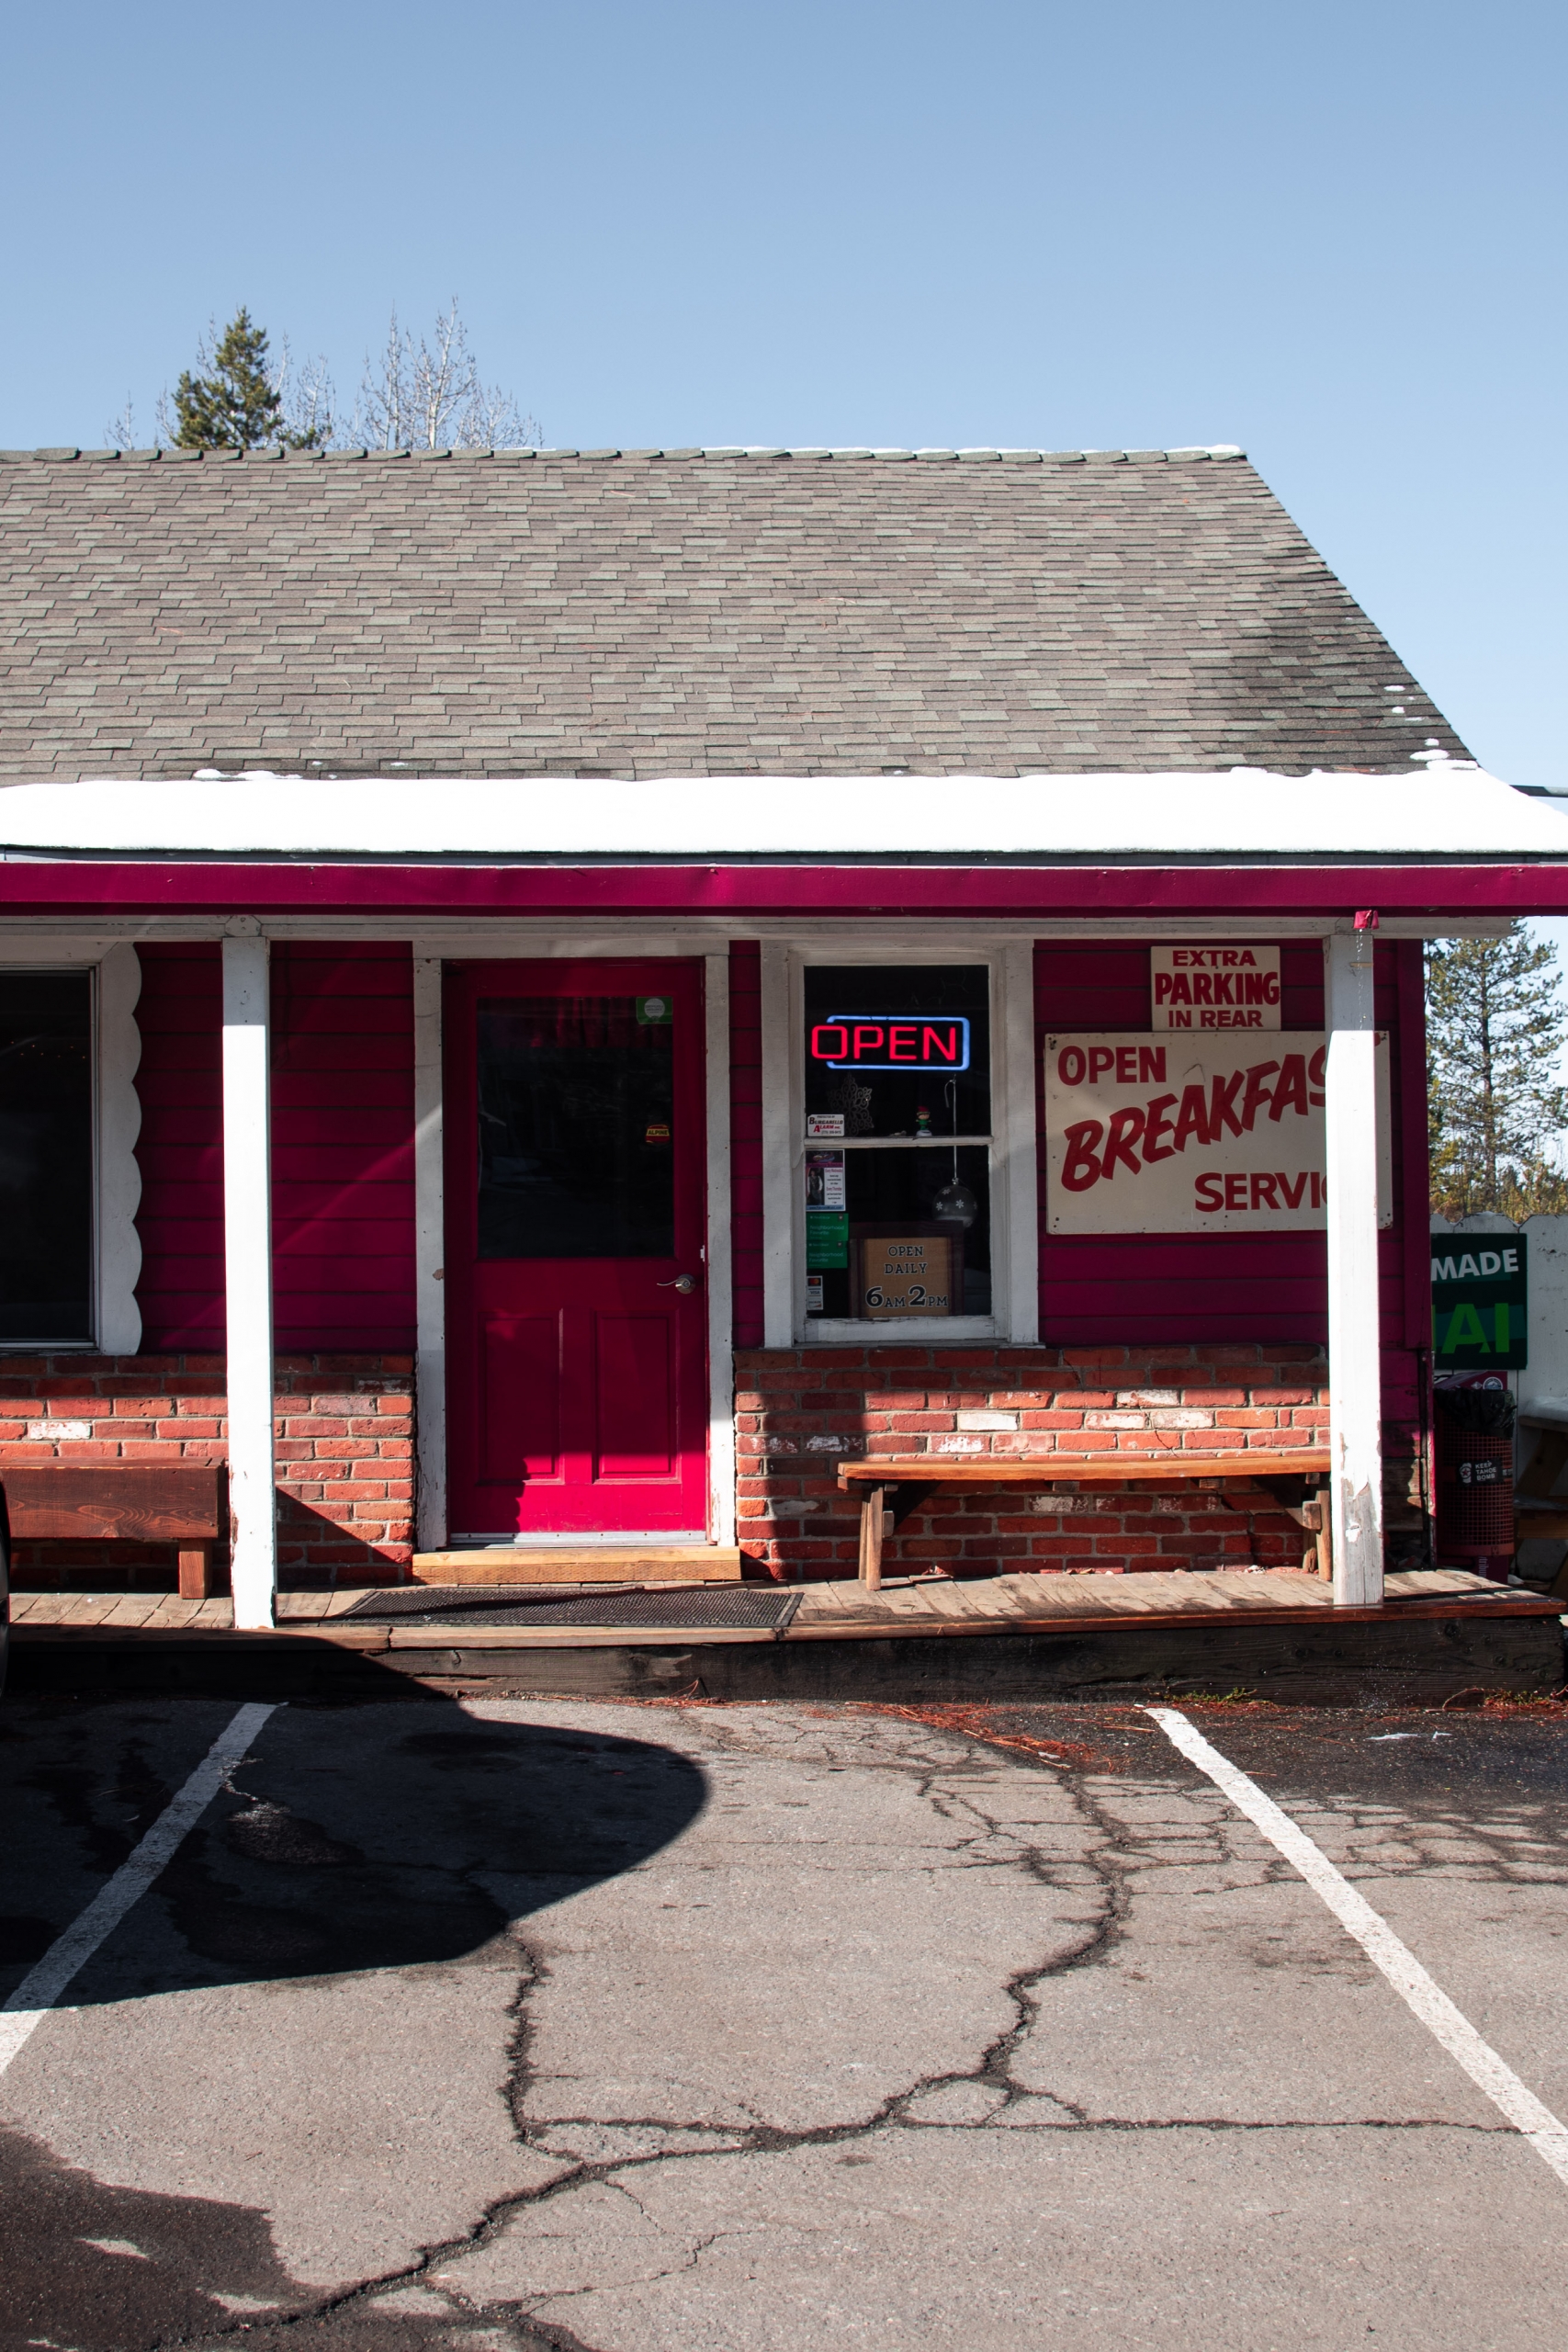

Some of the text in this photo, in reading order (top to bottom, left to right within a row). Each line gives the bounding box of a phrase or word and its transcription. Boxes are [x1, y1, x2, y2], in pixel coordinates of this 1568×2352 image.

[1172, 950, 1257, 967] EXTRA
[1155, 971, 1280, 1005] PARKING
[1168, 1010, 1264, 1027] IN REAR
[811, 1025, 956, 1060] OPEN
[1057, 1046, 1167, 1086] OPEN
[1060, 1033, 1380, 1193] BREAKFAS
[1194, 1171, 1328, 1213] SERVI
[884, 1262, 928, 1274] DAILY
[887, 1246, 924, 1257] OPEN
[1431, 1249, 1519, 1282] MADE
[1431, 1303, 1509, 1354] AI
